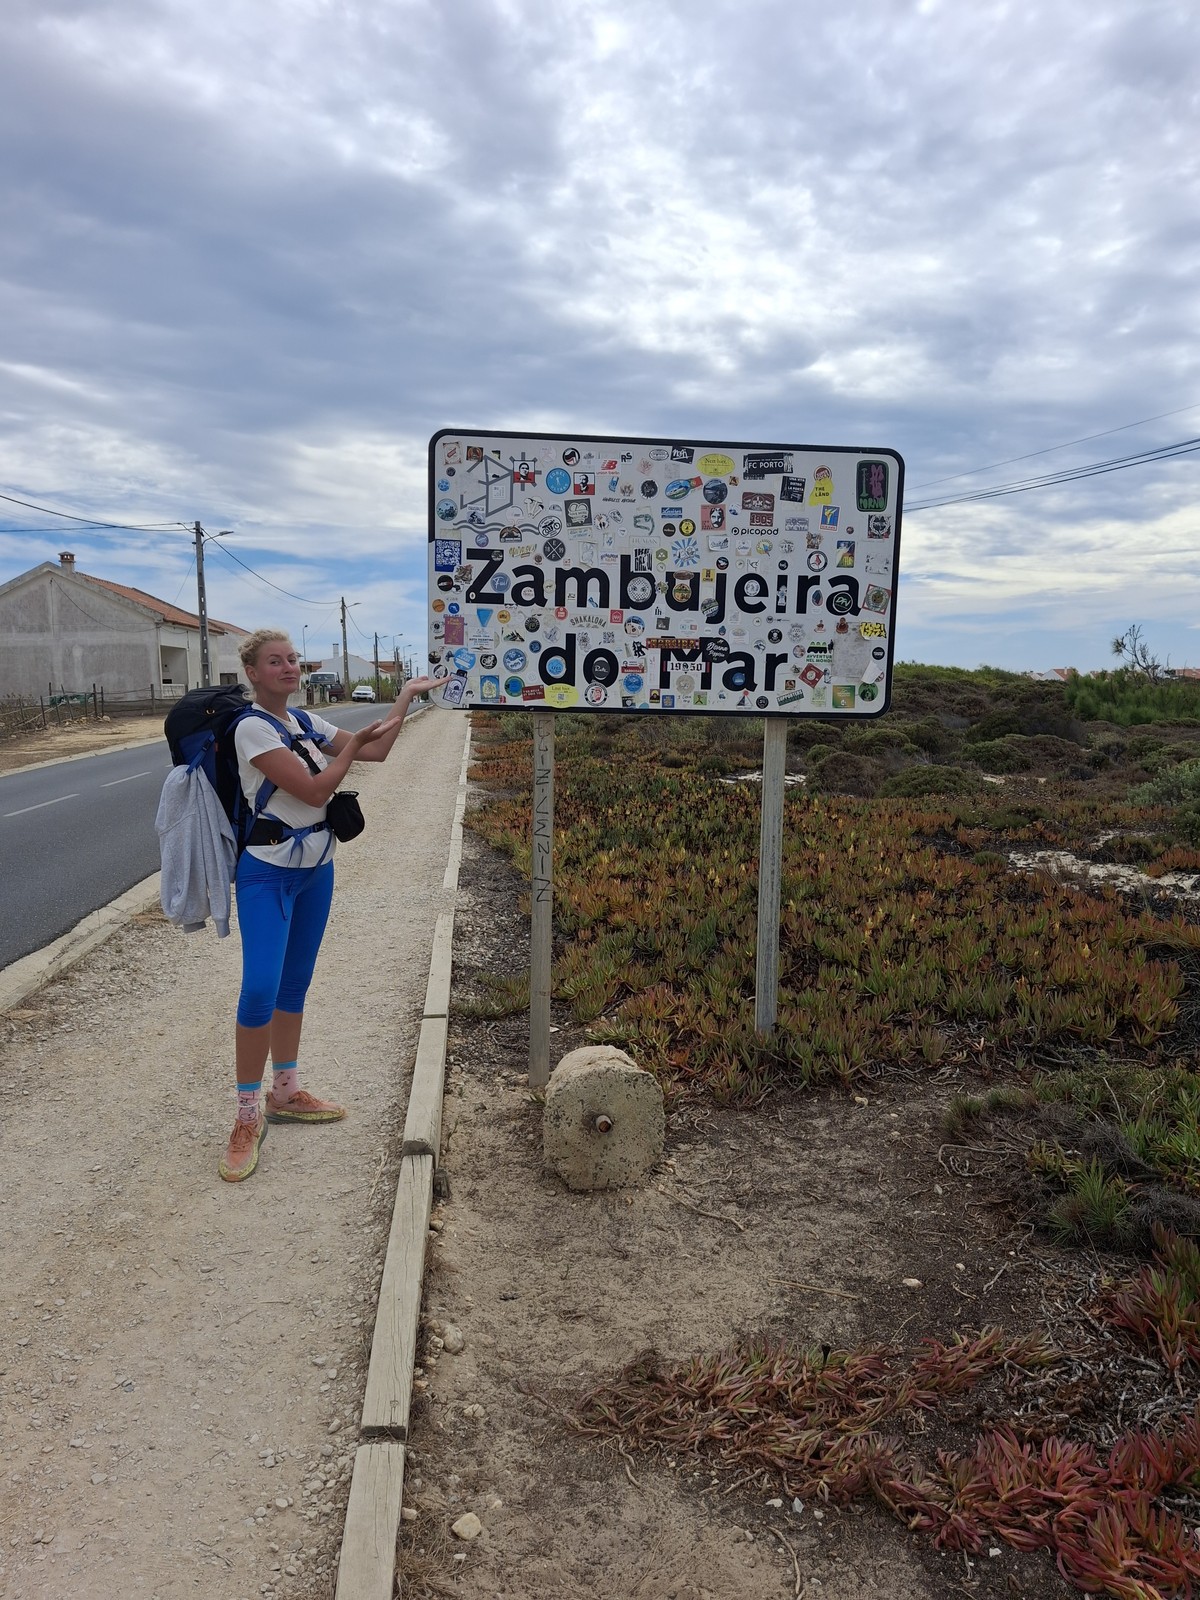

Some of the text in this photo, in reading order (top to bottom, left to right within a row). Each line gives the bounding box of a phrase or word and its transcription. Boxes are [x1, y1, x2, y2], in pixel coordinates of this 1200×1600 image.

[759, 461, 784, 469] PORTO
[751, 514, 773, 525] 1905
[741, 528, 779, 536] picopod
[466, 547, 862, 624] Zambujeira
[570, 615, 607, 628] SHAKALOHA
[538, 633, 788, 692] do Mar
